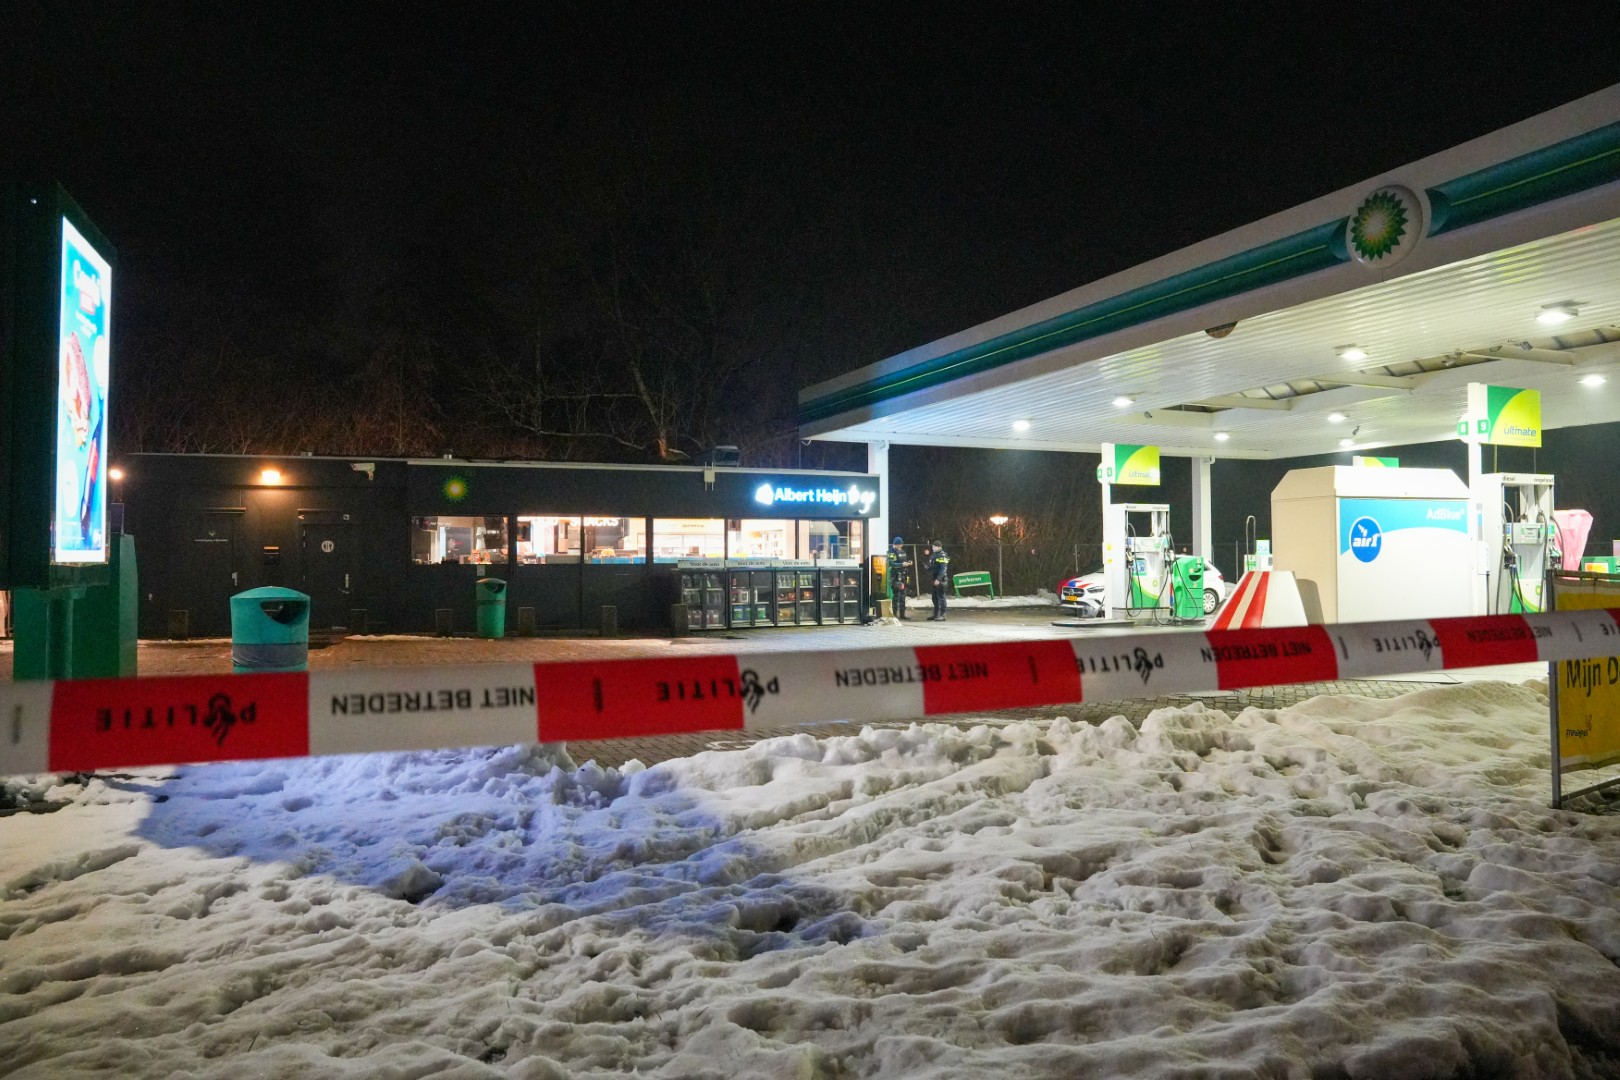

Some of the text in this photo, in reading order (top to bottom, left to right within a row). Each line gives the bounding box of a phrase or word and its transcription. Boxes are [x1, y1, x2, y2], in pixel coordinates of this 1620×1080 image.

[774, 487, 814, 502] Albert
[816, 488, 847, 505] Heijn
[835, 661, 988, 688] NIET BETREDEN
[1567, 655, 1620, 697] Mijn D
[331, 686, 536, 716] NIET BETREDEN
